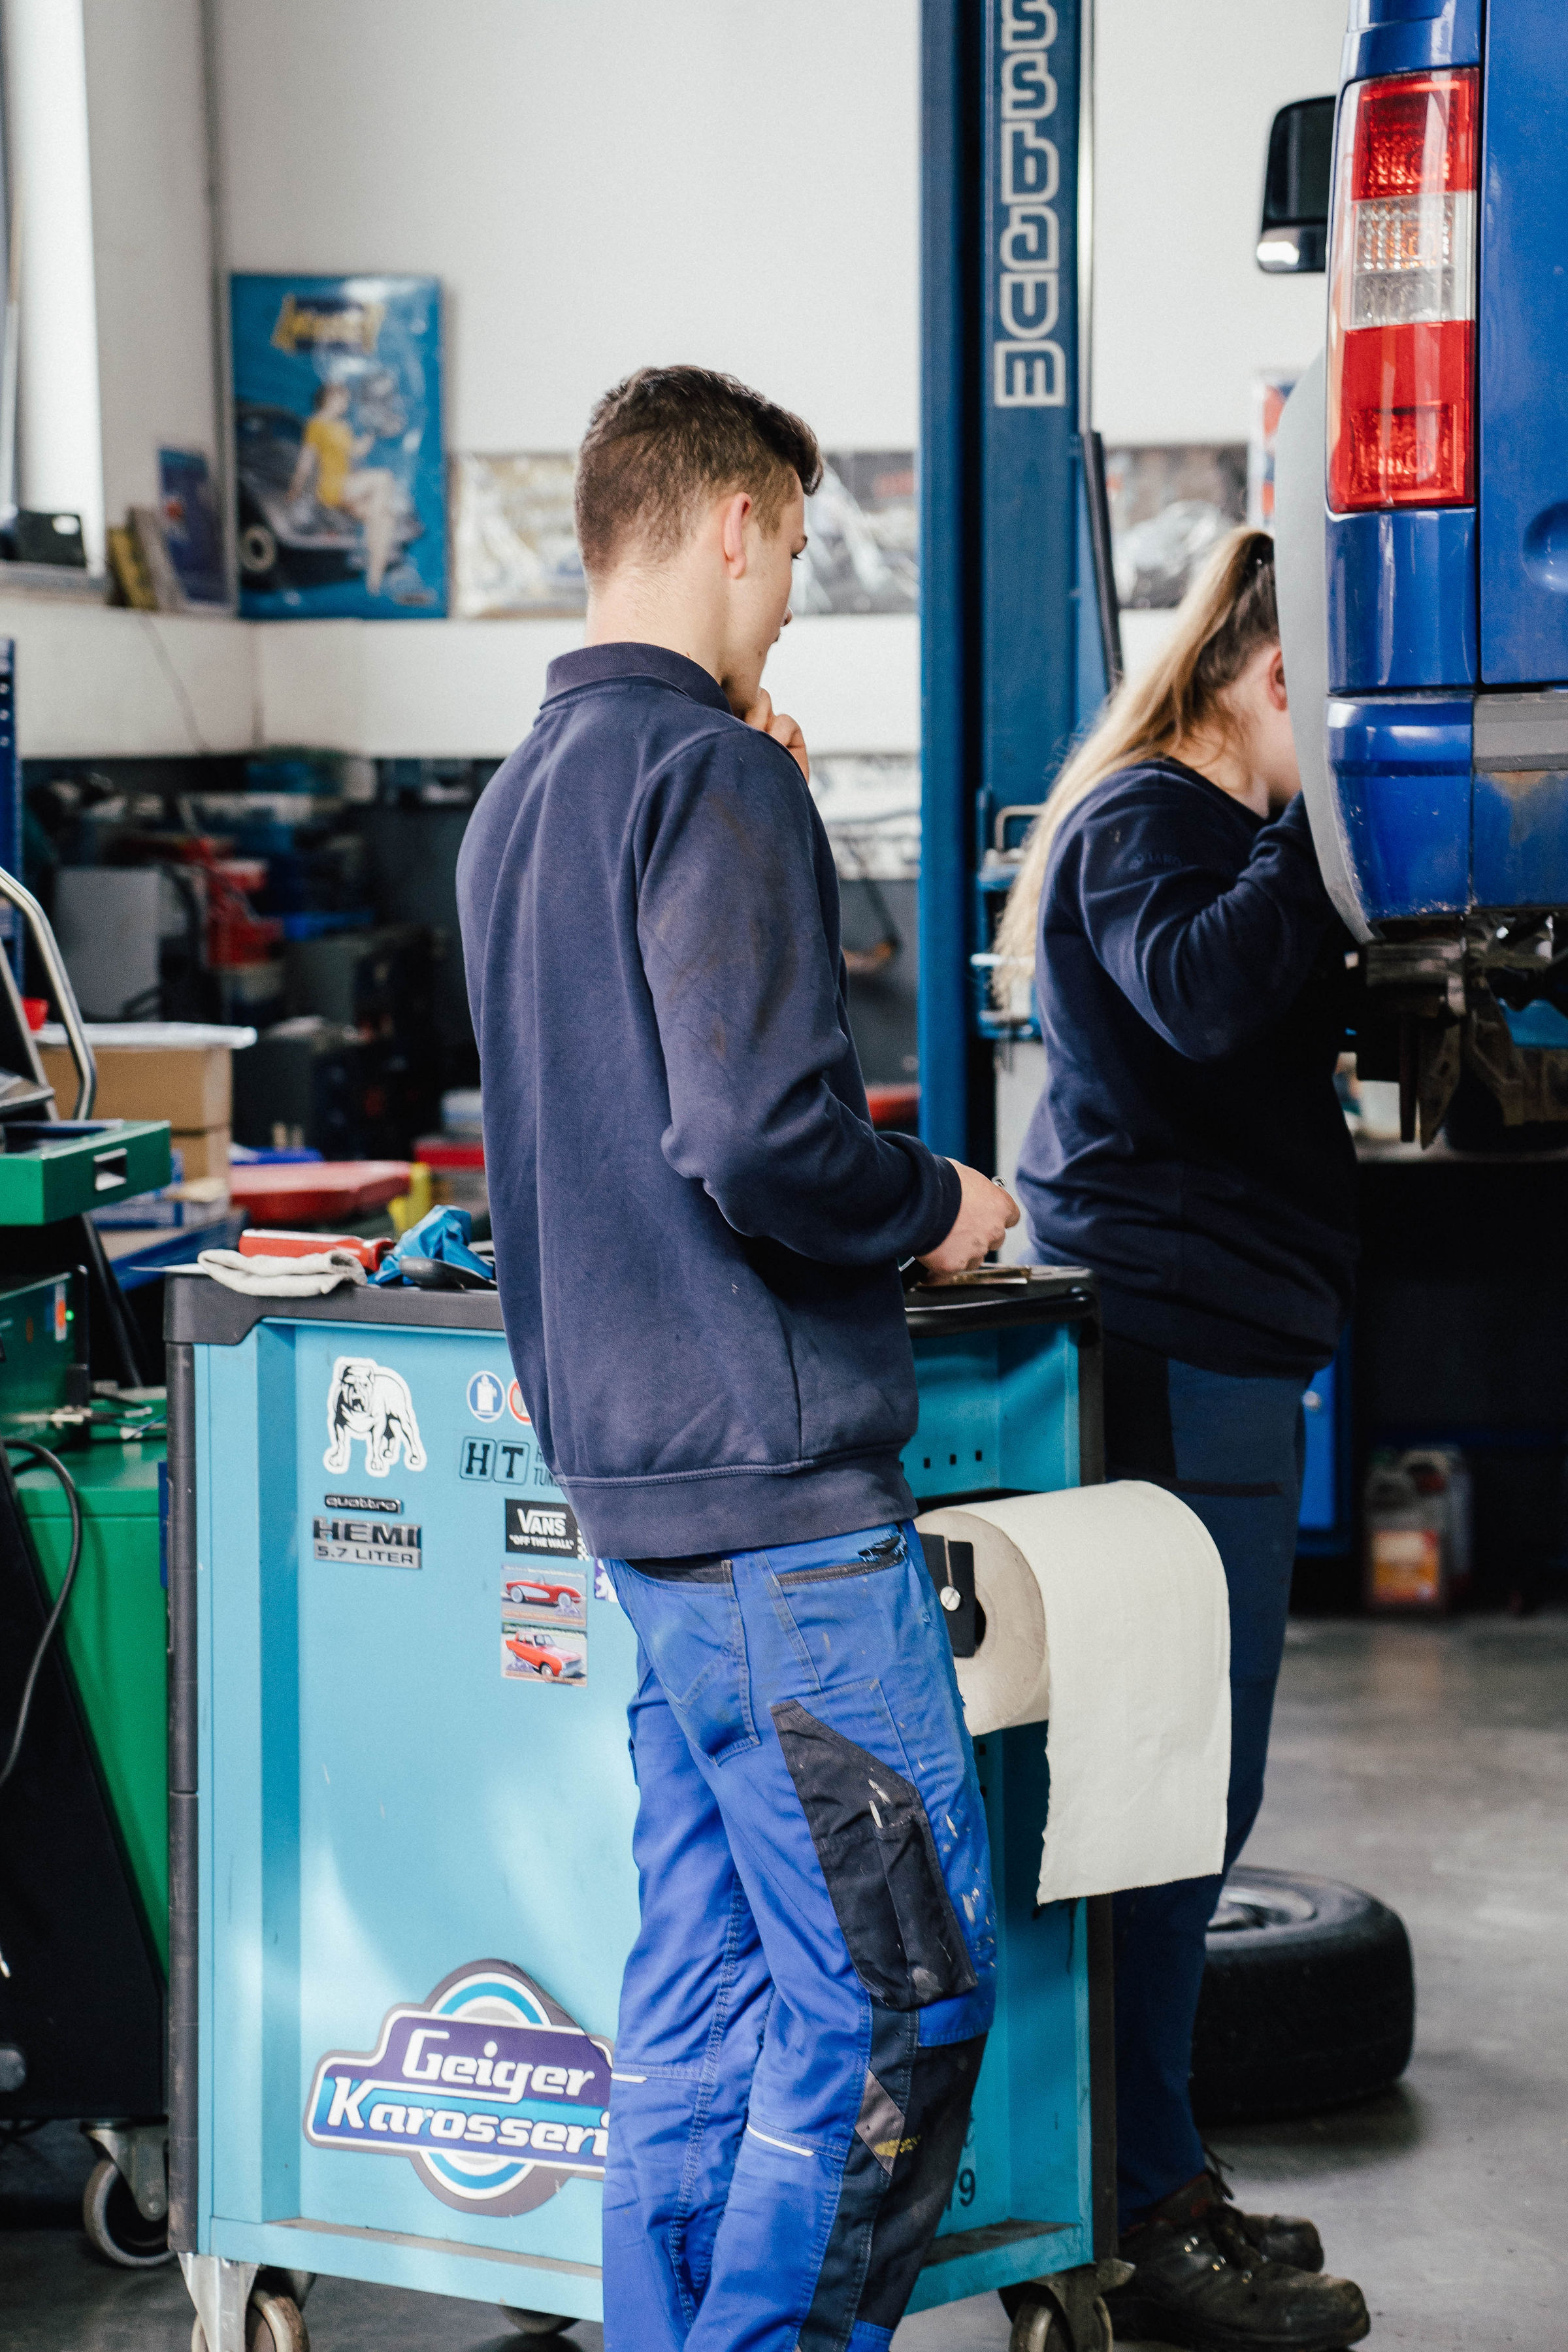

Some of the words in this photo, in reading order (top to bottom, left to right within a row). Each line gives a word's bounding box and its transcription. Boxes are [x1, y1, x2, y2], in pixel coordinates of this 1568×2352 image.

[325, 1495, 397, 1512] quattro
[313, 1518, 418, 1548] HEMI
[517, 1508, 567, 1537] VANS
[531, 1535, 547, 1548] THE
[317, 1544, 347, 1558] 5.7
[355, 1548, 414, 1564] LITER
[402, 2027, 595, 2104] Geiger
